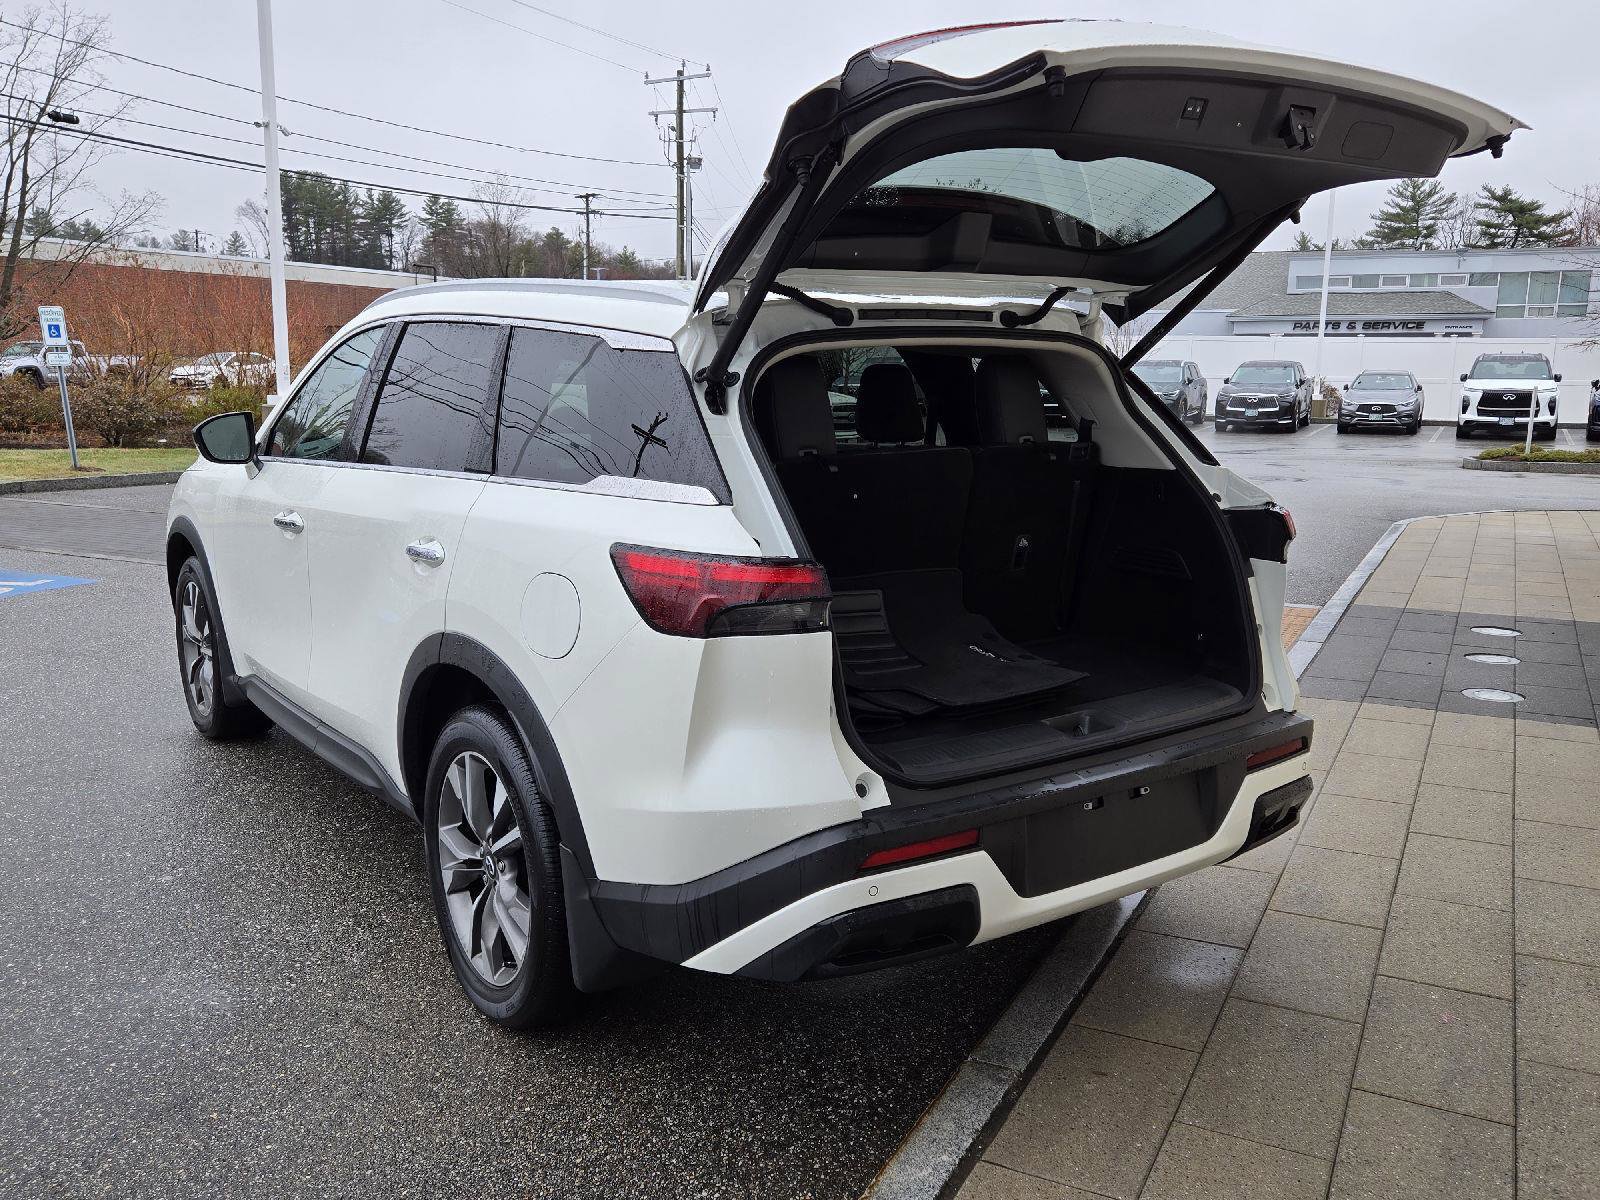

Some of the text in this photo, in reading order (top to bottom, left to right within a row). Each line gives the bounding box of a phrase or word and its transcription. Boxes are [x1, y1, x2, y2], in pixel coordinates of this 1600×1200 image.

[1293, 321, 1426, 331] PARTS & SERVICE
